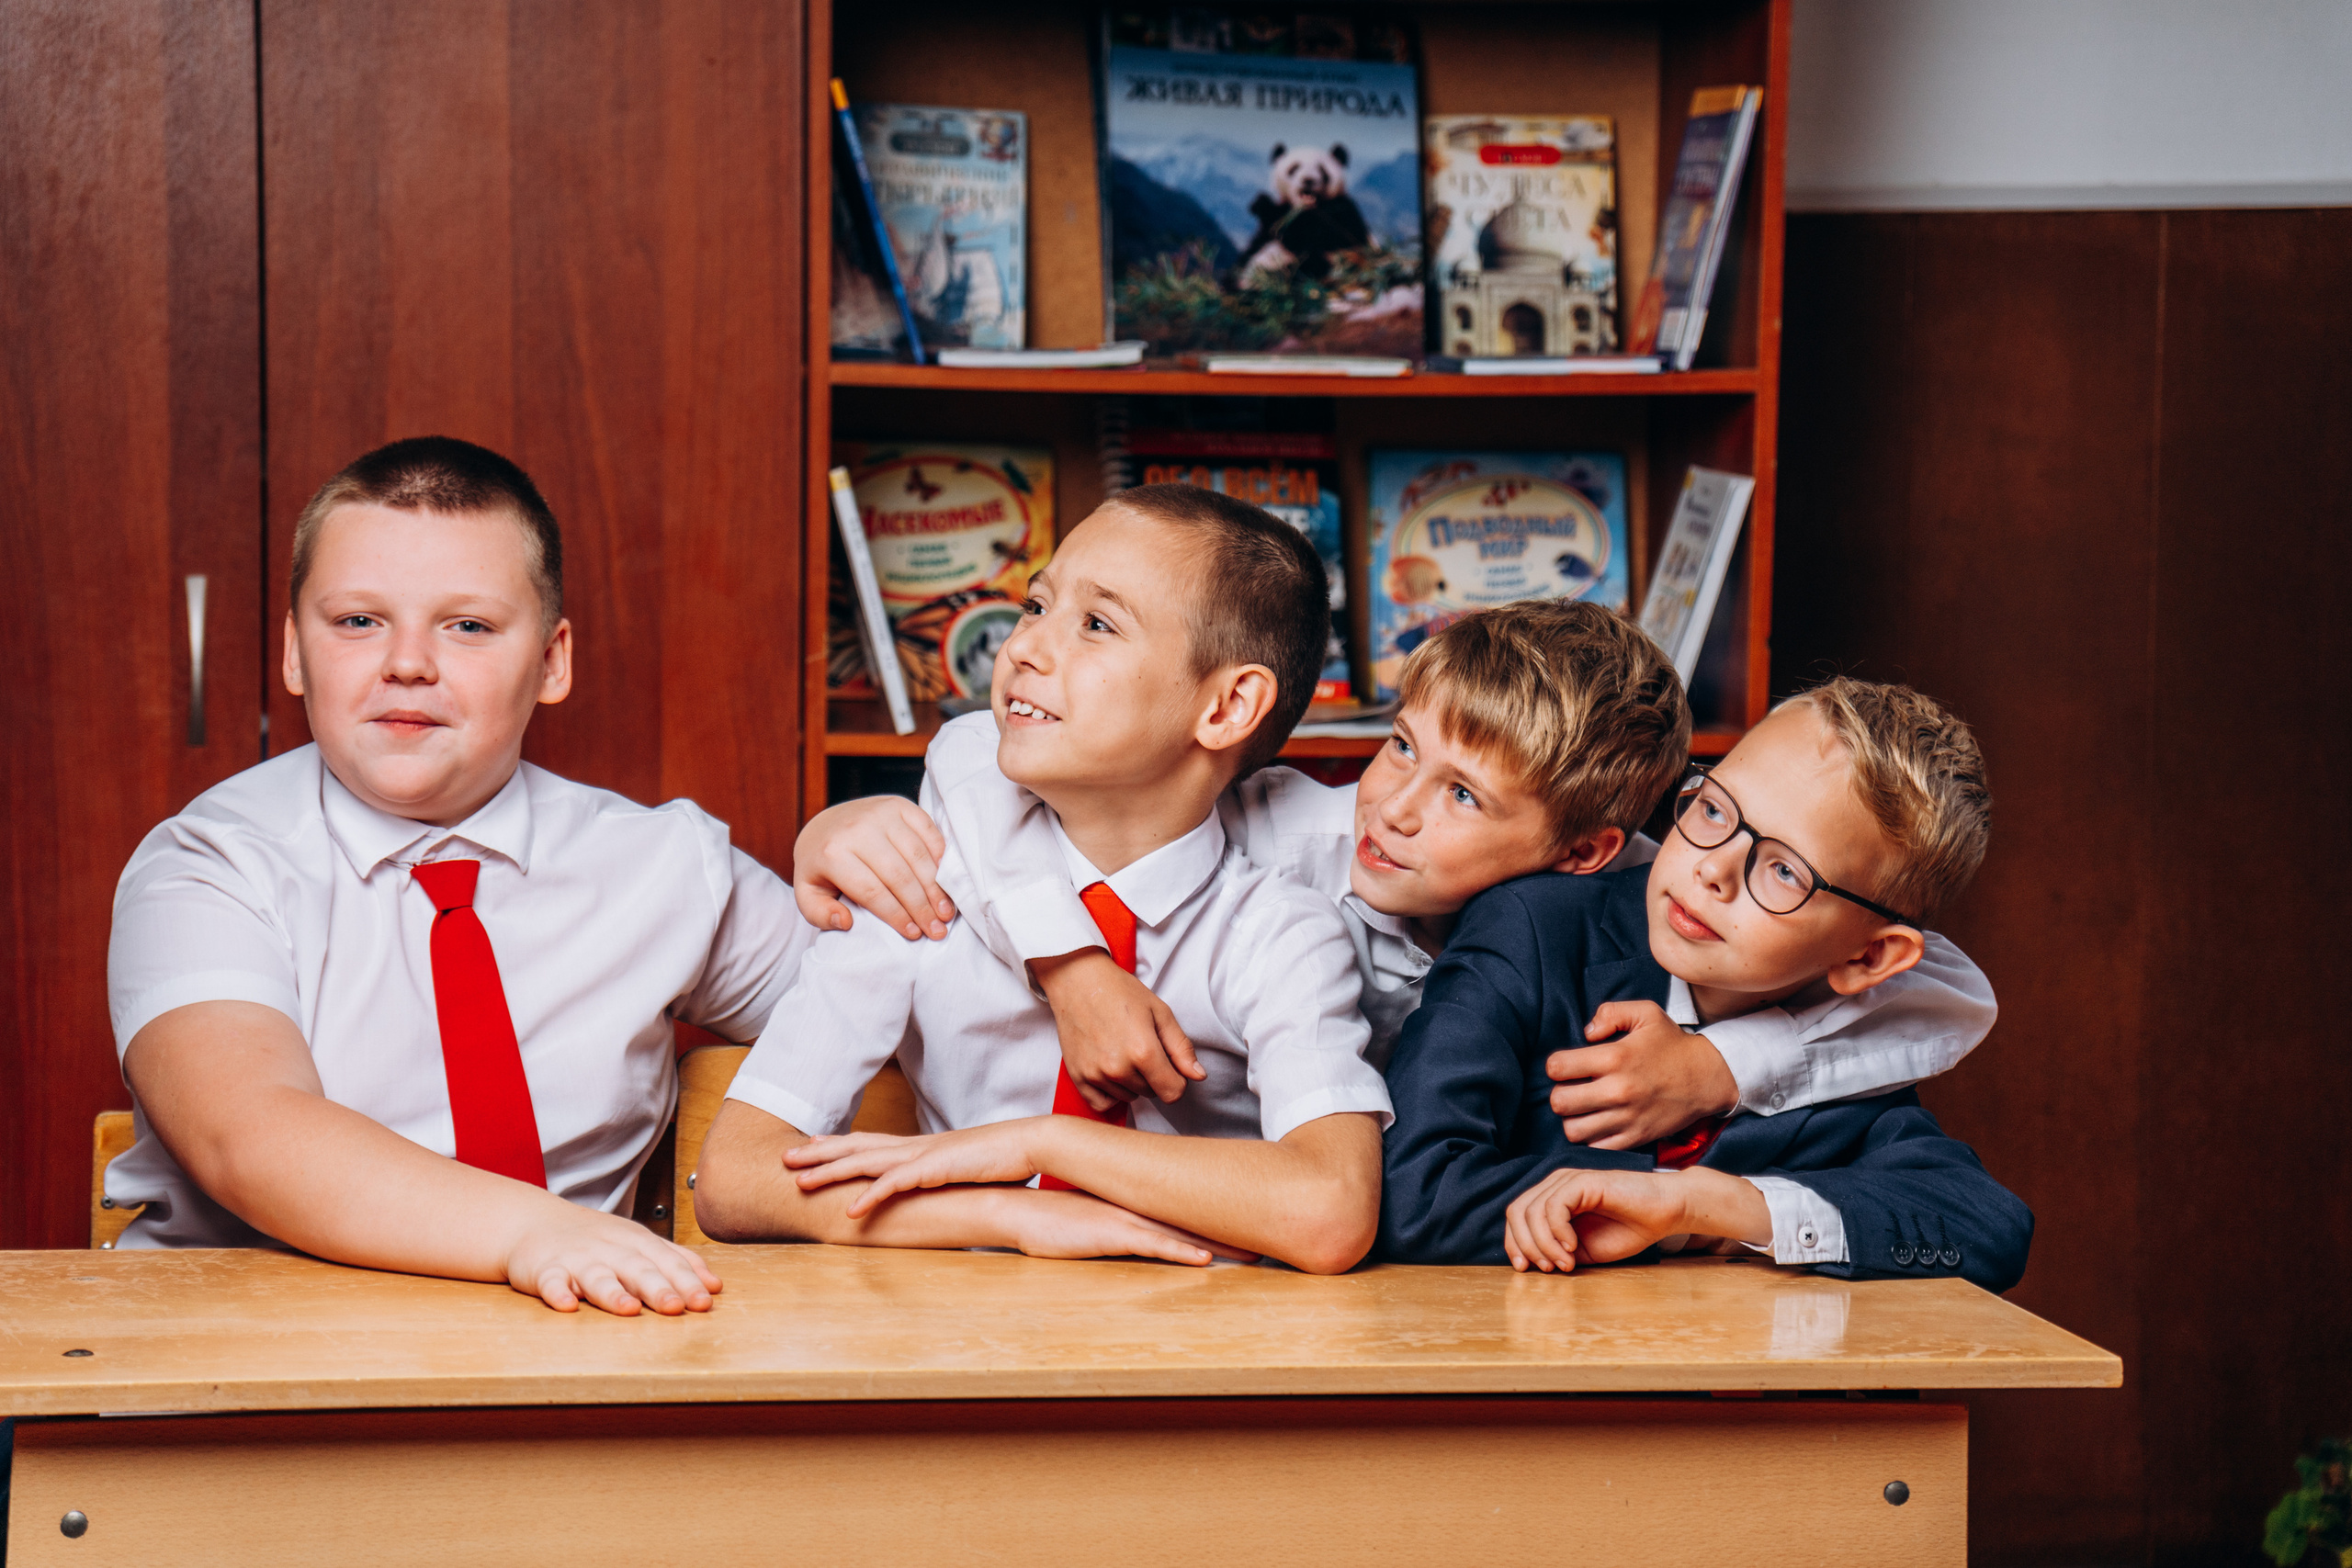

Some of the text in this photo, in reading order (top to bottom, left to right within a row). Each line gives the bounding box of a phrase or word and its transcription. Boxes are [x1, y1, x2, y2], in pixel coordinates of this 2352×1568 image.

[1125, 73, 1242, 108] ЖИВАЯ
[1255, 82, 1407, 118] ПРИРОДА
[1446, 171, 1588, 201] ЧУДЕСА
[1478, 538, 1530, 561] МИР
